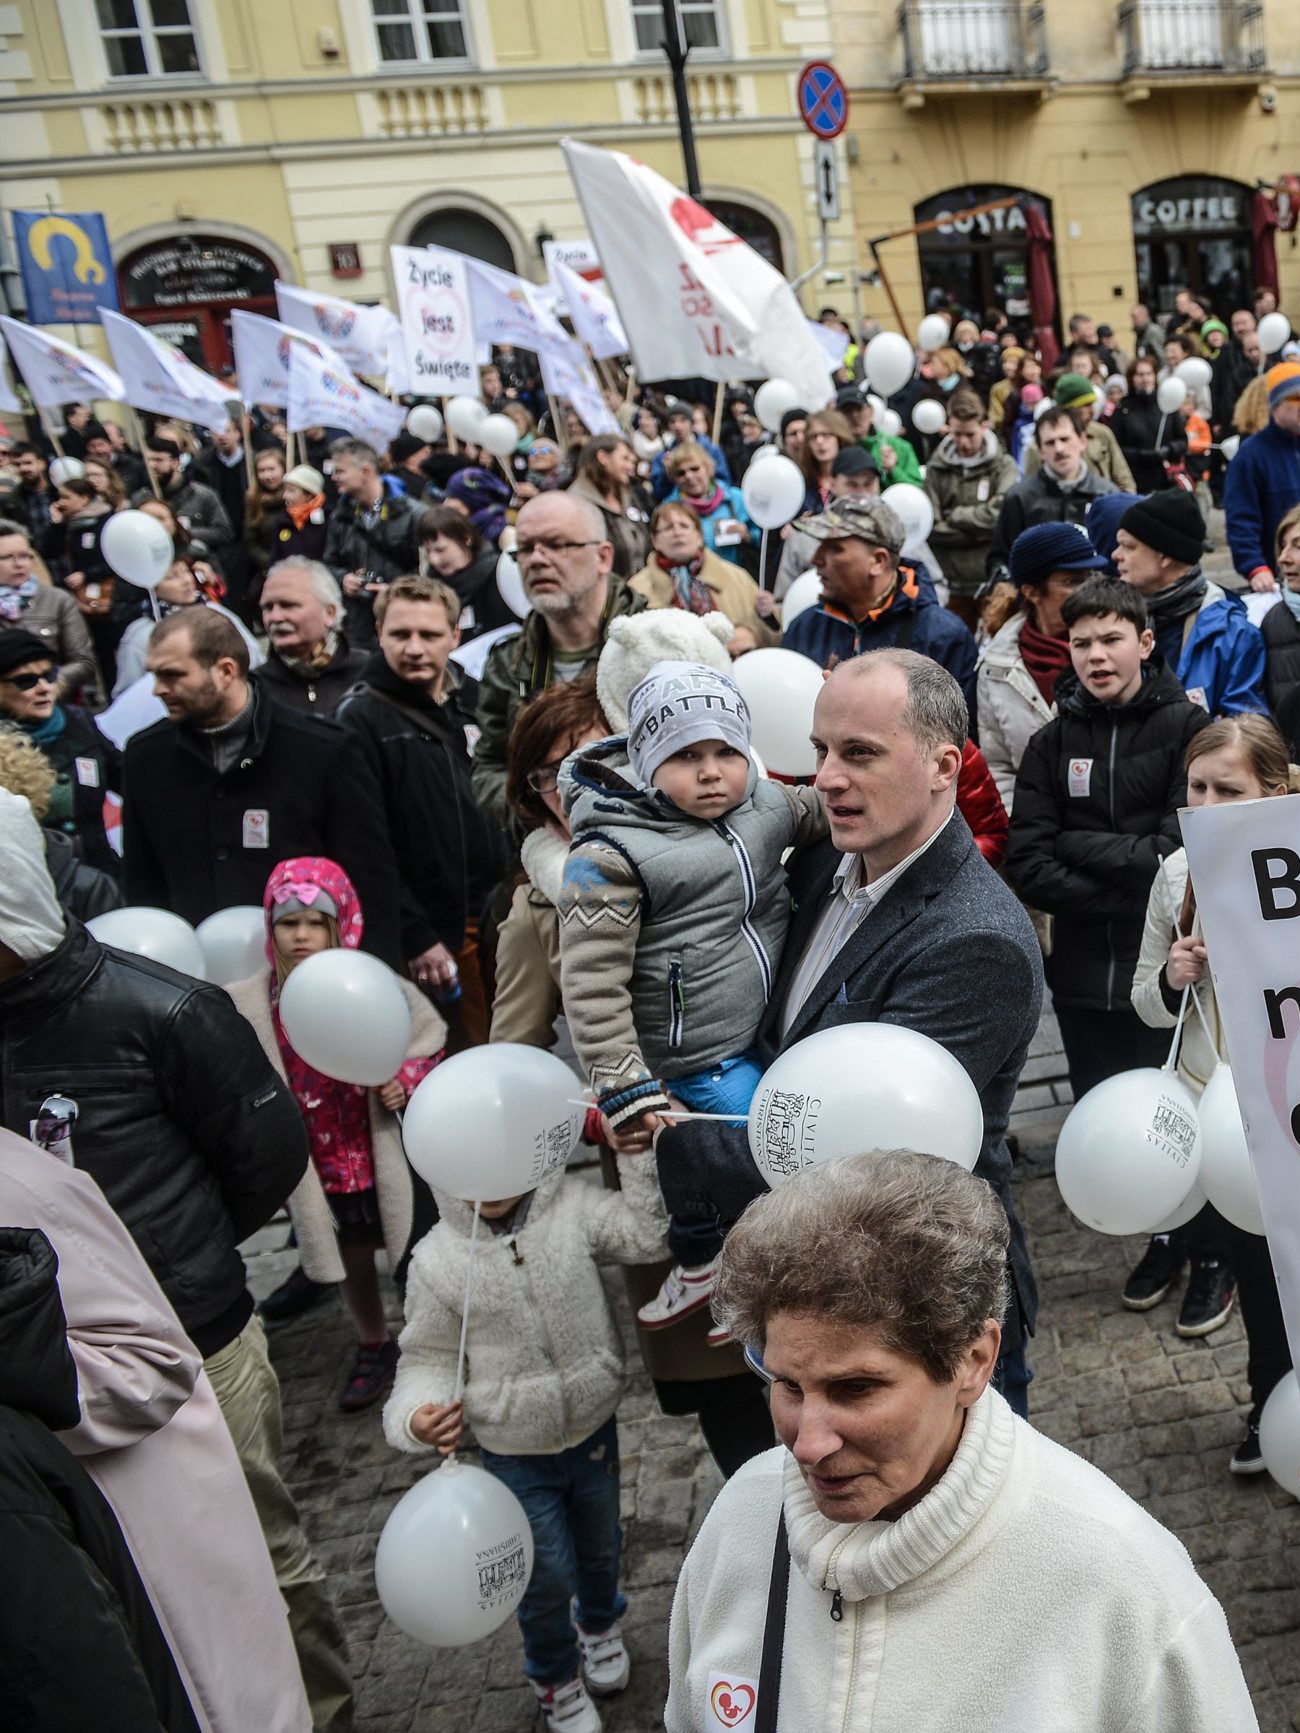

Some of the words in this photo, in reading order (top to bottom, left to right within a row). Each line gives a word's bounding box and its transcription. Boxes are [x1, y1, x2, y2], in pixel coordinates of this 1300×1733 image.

[936, 206, 1026, 236] COSTA
[1139, 196, 1238, 224] COFFEE
[645, 694, 745, 736] BATTLE
[804, 1099, 822, 1167] CIVITA
